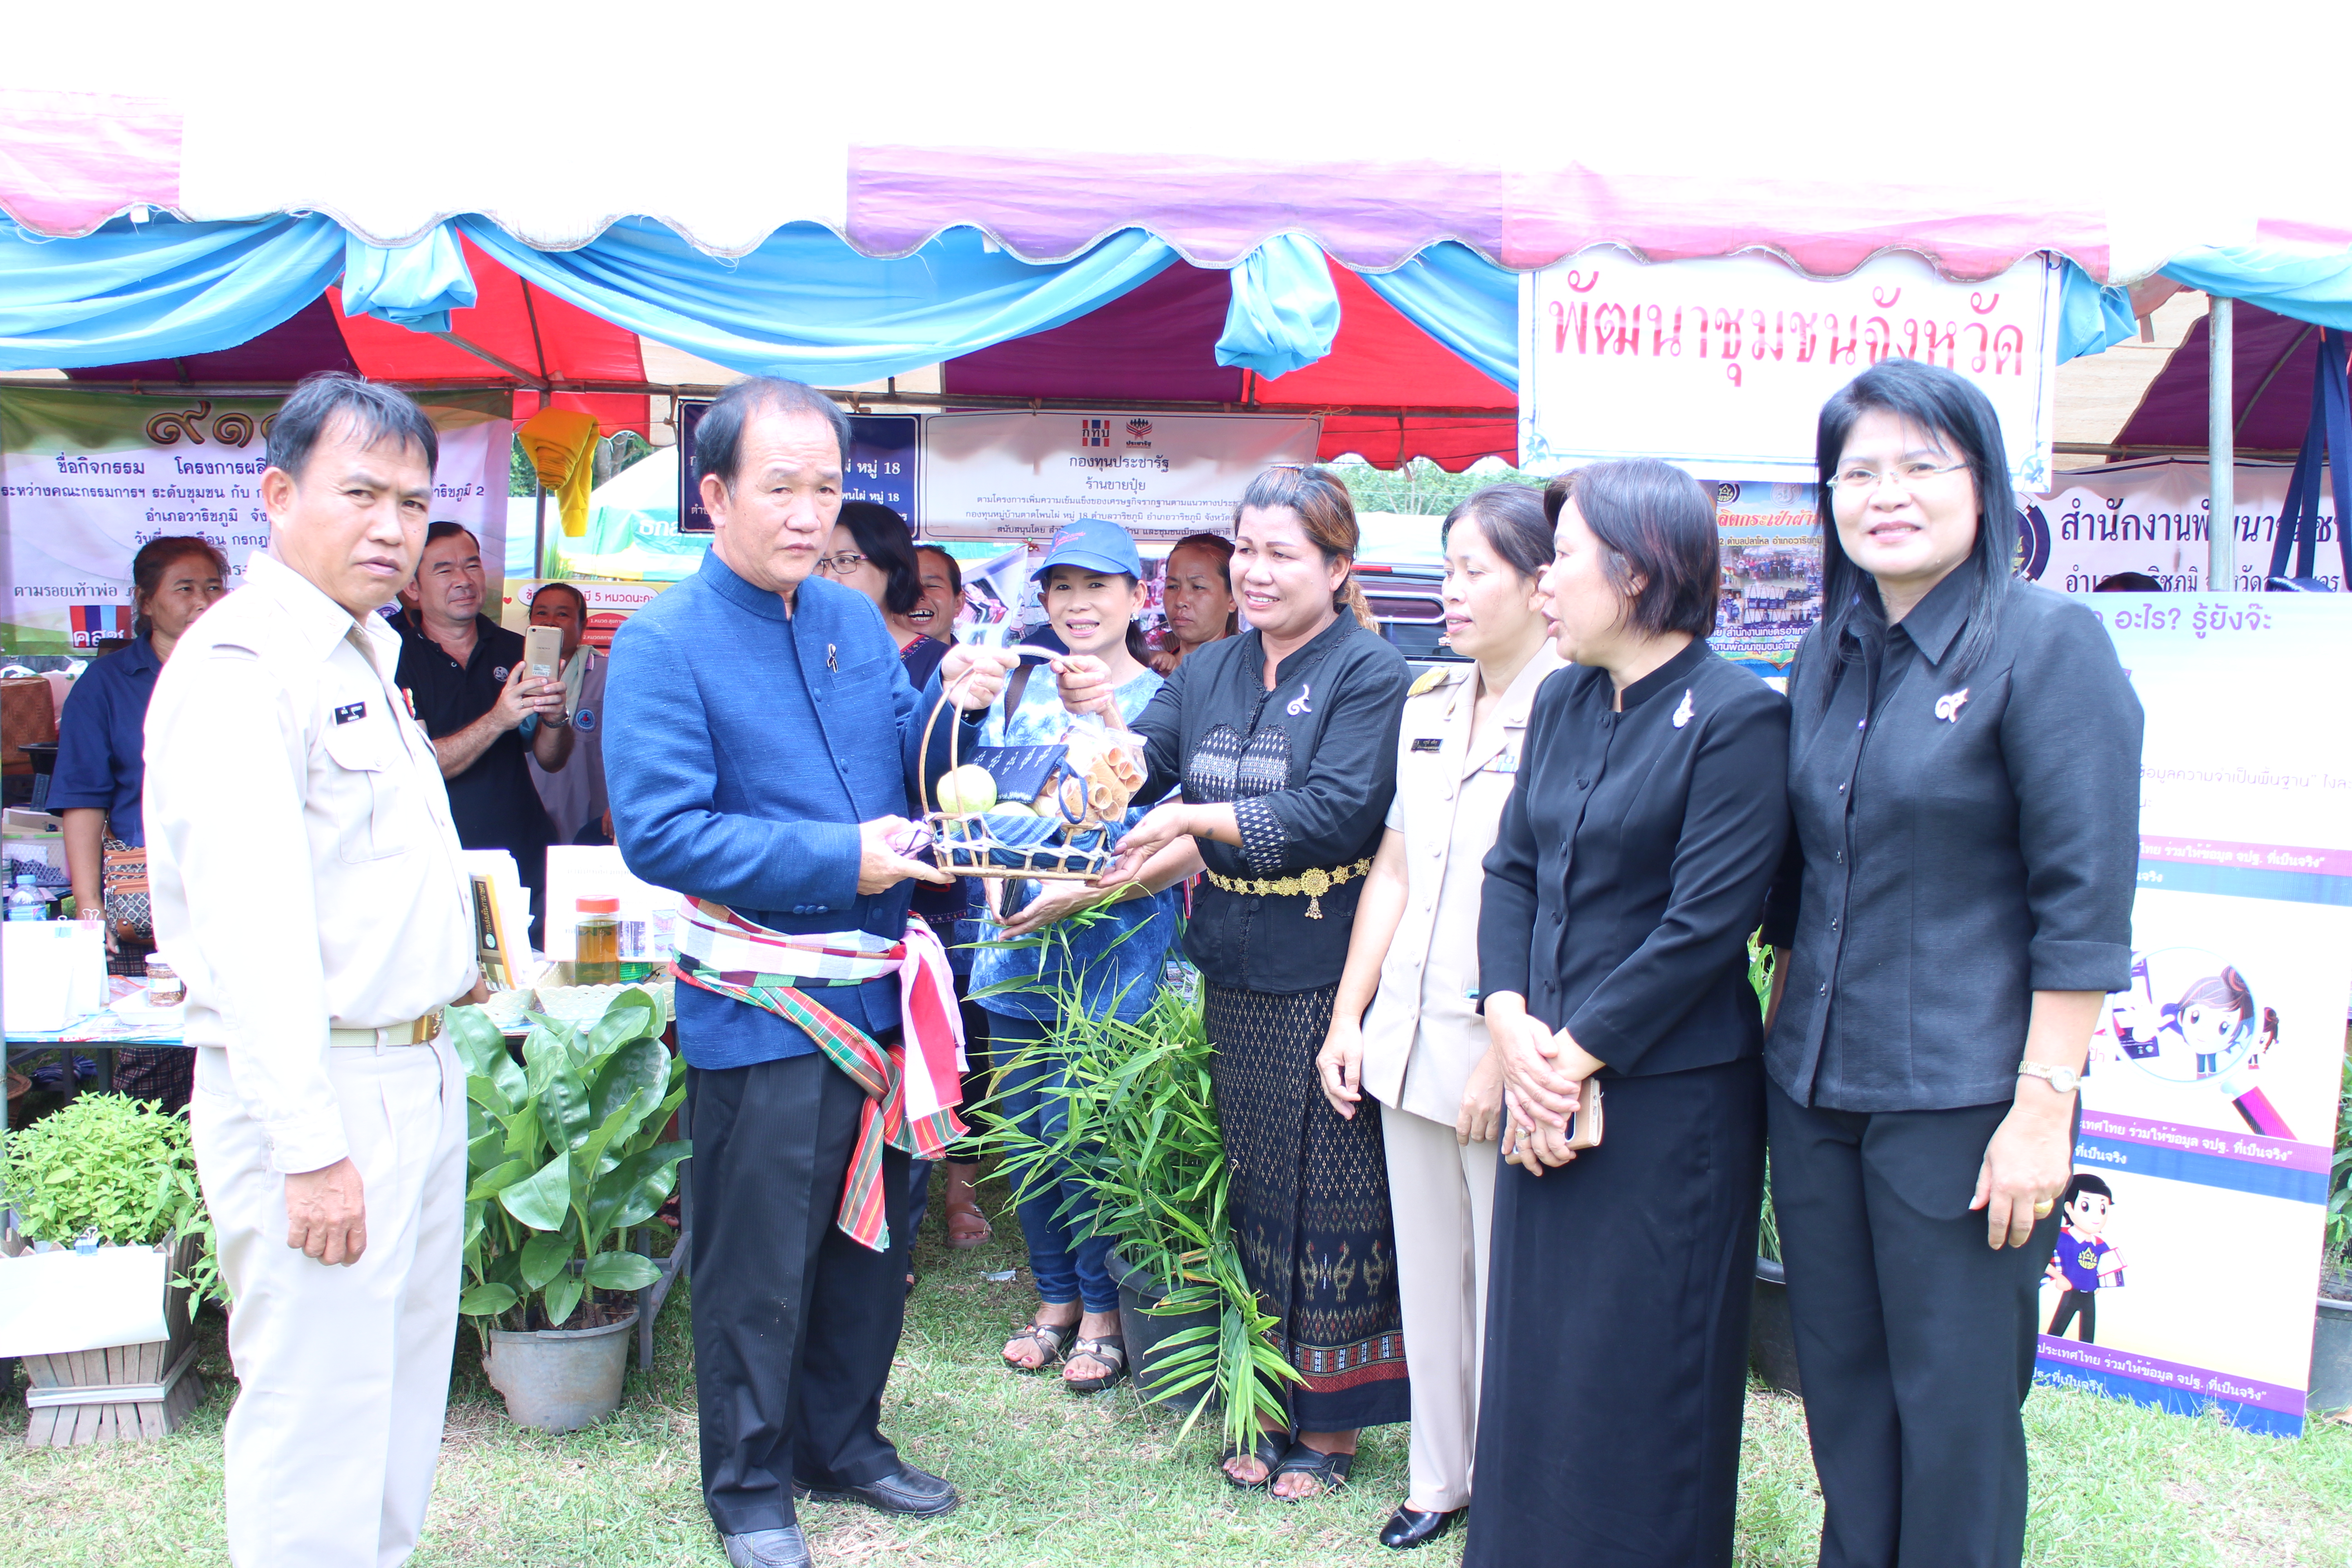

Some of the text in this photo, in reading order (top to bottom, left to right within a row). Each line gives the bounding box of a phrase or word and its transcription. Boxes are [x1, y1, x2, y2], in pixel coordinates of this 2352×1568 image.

[1548, 269, 2024, 387] พัฒนาชุมชนจังหวัด
[55, 452, 145, 475] ชื่อกิจกรรม
[857, 460, 878, 479] หมู่
[884, 462, 901, 475] 18
[1069, 455, 1169, 472] กองทุนประชารัฐ
[0, 482, 146, 498] ระหว่างคณะกรรมการฯ
[152, 484, 225, 504] ระดับชุมชน
[231, 484, 250, 498] กับ
[476, 486, 485, 496] 2
[1086, 476, 1146, 495] ร้านขายปุ๋ย
[869, 491, 884, 505] หมู่
[888, 493, 900, 502] 18
[146, 507, 238, 528] อำเภอวาริชภูมิ
[1063, 510, 1075, 521] หมู่
[1091, 512, 1143, 523] ตำบลวาริชภูมิ
[1147, 512, 1201, 523] อำเภอวาริชภูมิ
[997, 524, 1045, 535] สนับสนุนโดย
[1727, 535, 1769, 546] ตำบลปลาโหล
[14, 582, 118, 597] ตามรอยเท้าพ่อ
[595, 593, 601, 602] 5
[2115, 603, 2181, 630] อะไร?
[2192, 602, 2271, 639] รู้ยังจ๊ะ
[2165, 841, 2232, 863] ร่วมให้ข้อมูล
[2129, 1122, 2198, 1148] ร่วมให้ข้อมูล
[2202, 1138, 2229, 1153] จปฐ.
[2037, 1342, 2100, 1366] ประเทศไทย
[2104, 1353, 2173, 1382] ร่วมให้ข้อมูล
[2177, 1373, 2204, 1390] จปฐ.
